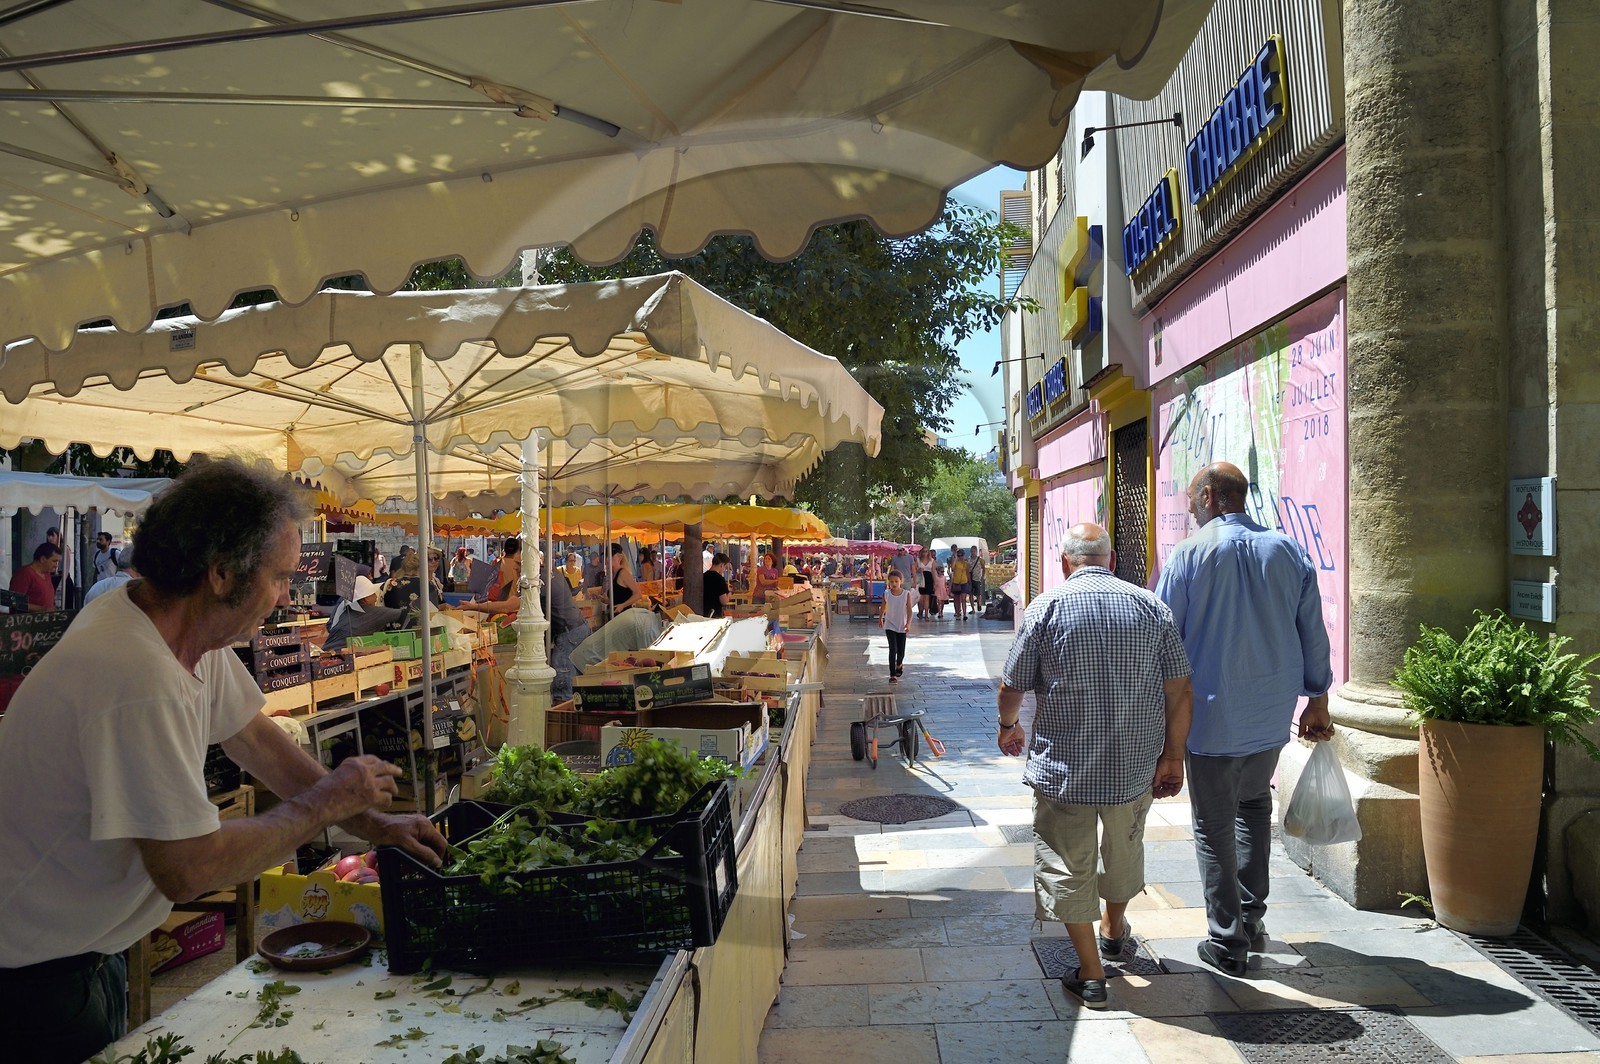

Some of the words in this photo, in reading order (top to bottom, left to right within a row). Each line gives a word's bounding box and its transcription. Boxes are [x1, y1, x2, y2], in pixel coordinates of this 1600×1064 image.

[1122, 178, 1178, 277] CASTEL
[1187, 40, 1283, 206] CHABRE
[1292, 345, 1303, 368] 28
[1310, 330, 1335, 360] JUIN
[1291, 373, 1335, 407] JUILLET
[1304, 414, 1329, 441] 2018
[5, 611, 68, 627] AVOCATS
[265, 635, 291, 647] CONQUET
[269, 655, 299, 668] CONQUET
[323, 664, 345, 676] CONQUET
[271, 675, 300, 689] CONQUET
[676, 687, 694, 696] fruits
[184, 915, 218, 936] Amandine
